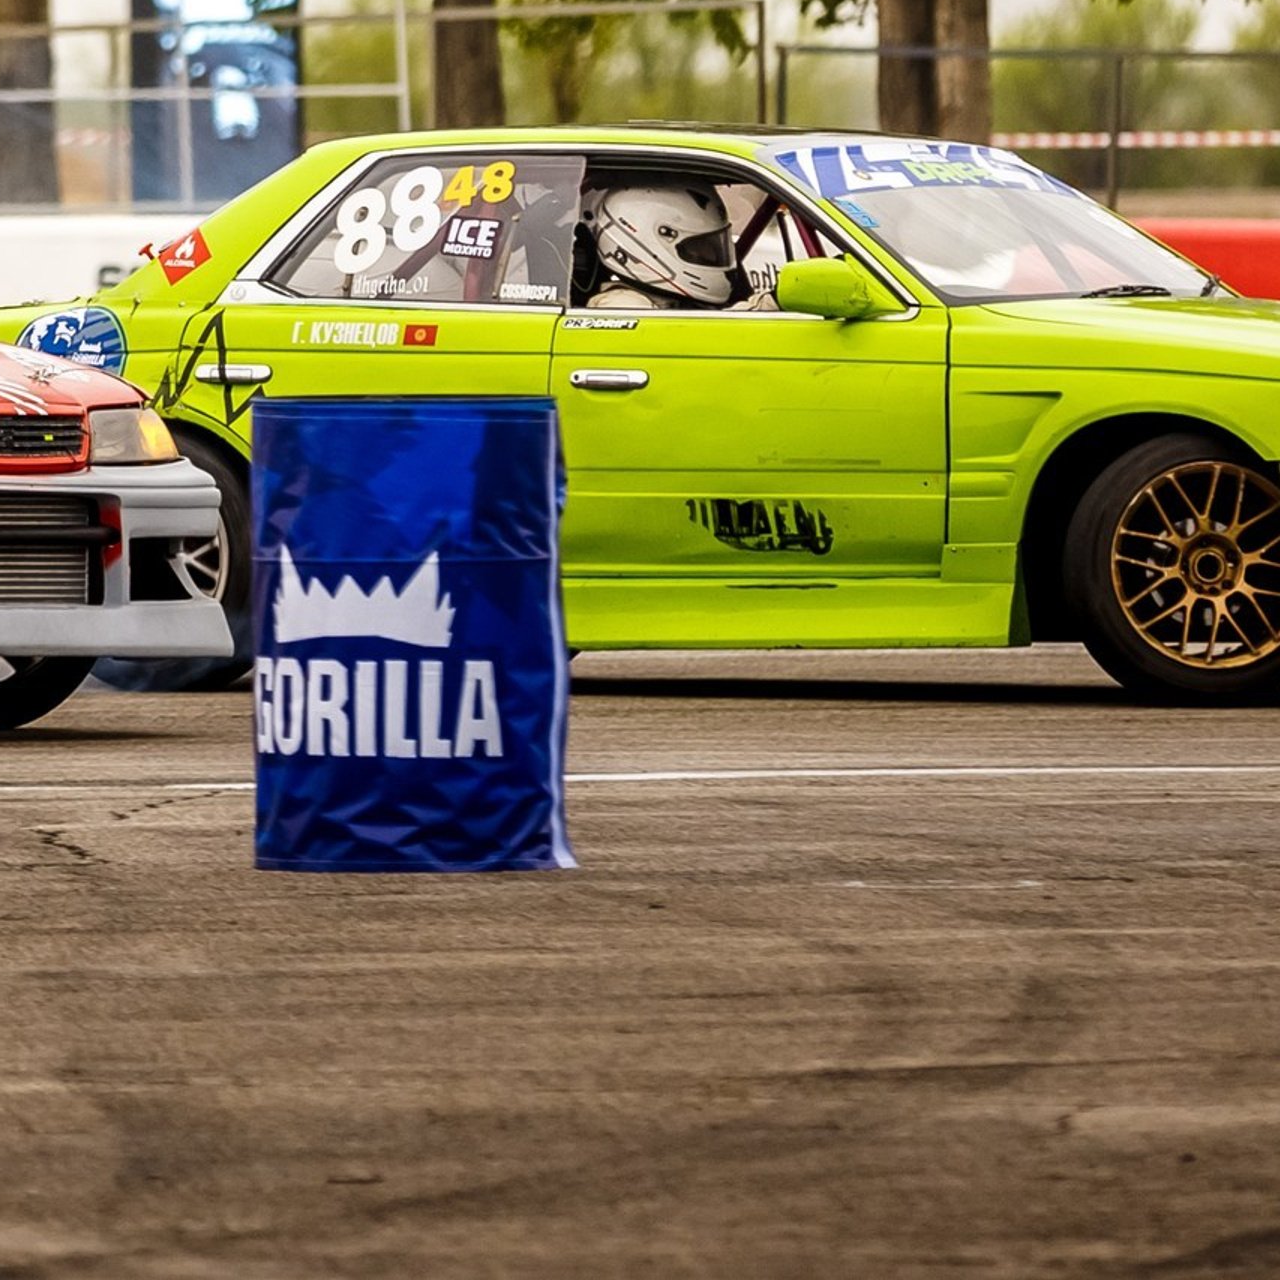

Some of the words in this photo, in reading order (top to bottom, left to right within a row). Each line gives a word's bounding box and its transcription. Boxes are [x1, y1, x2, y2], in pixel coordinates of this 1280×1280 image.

[444, 161, 515, 205] 48
[335, 166, 443, 274] 88
[448, 219, 499, 246] ICE
[291, 321, 306, 345] Г.
[309, 321, 400, 349] КУЗНЕЦОВ
[255, 656, 504, 759] GORILLA
